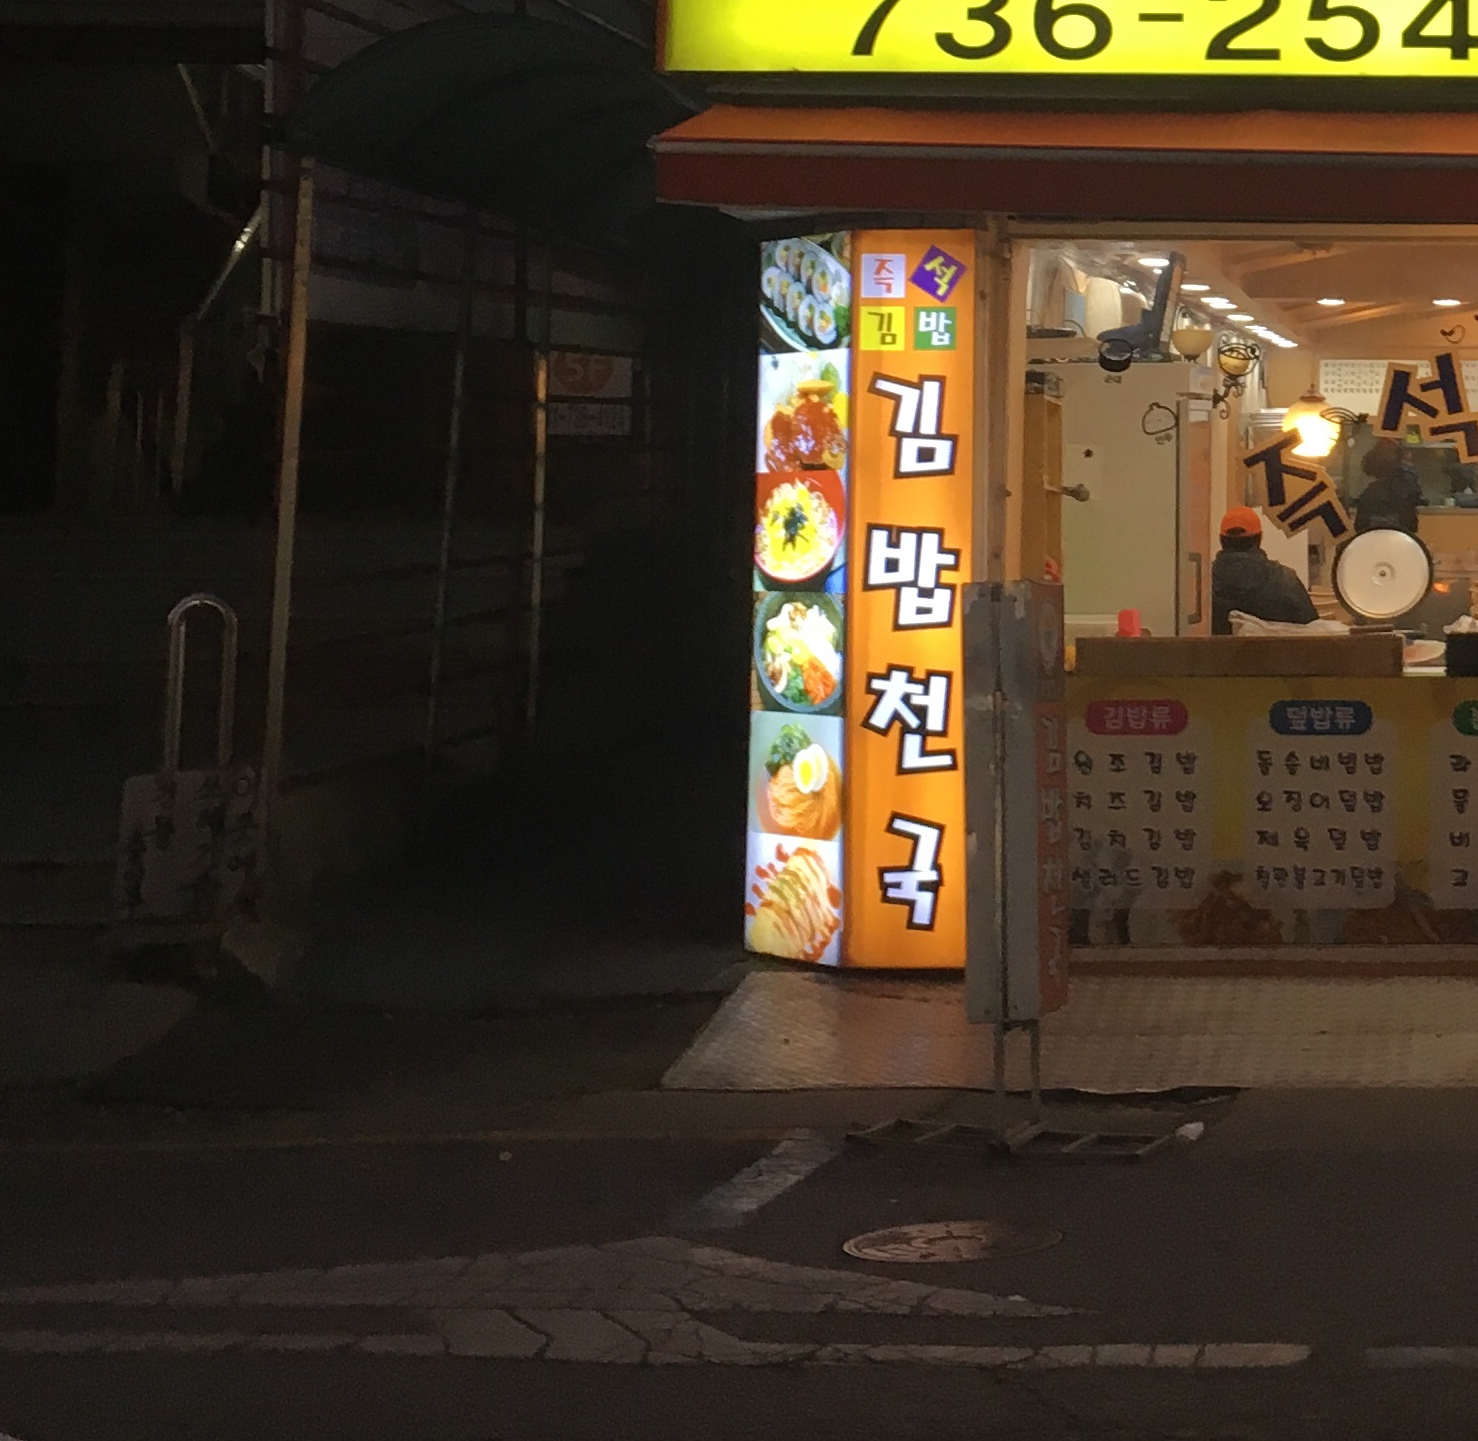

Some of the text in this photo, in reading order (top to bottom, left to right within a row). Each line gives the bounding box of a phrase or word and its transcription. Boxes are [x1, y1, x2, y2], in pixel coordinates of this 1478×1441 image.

[868, 255, 957, 298] 즉석
[866, 309, 954, 347] 김밥
[861, 371, 961, 931] 김밥천국
[1103, 706, 1174, 730] 김밥류
